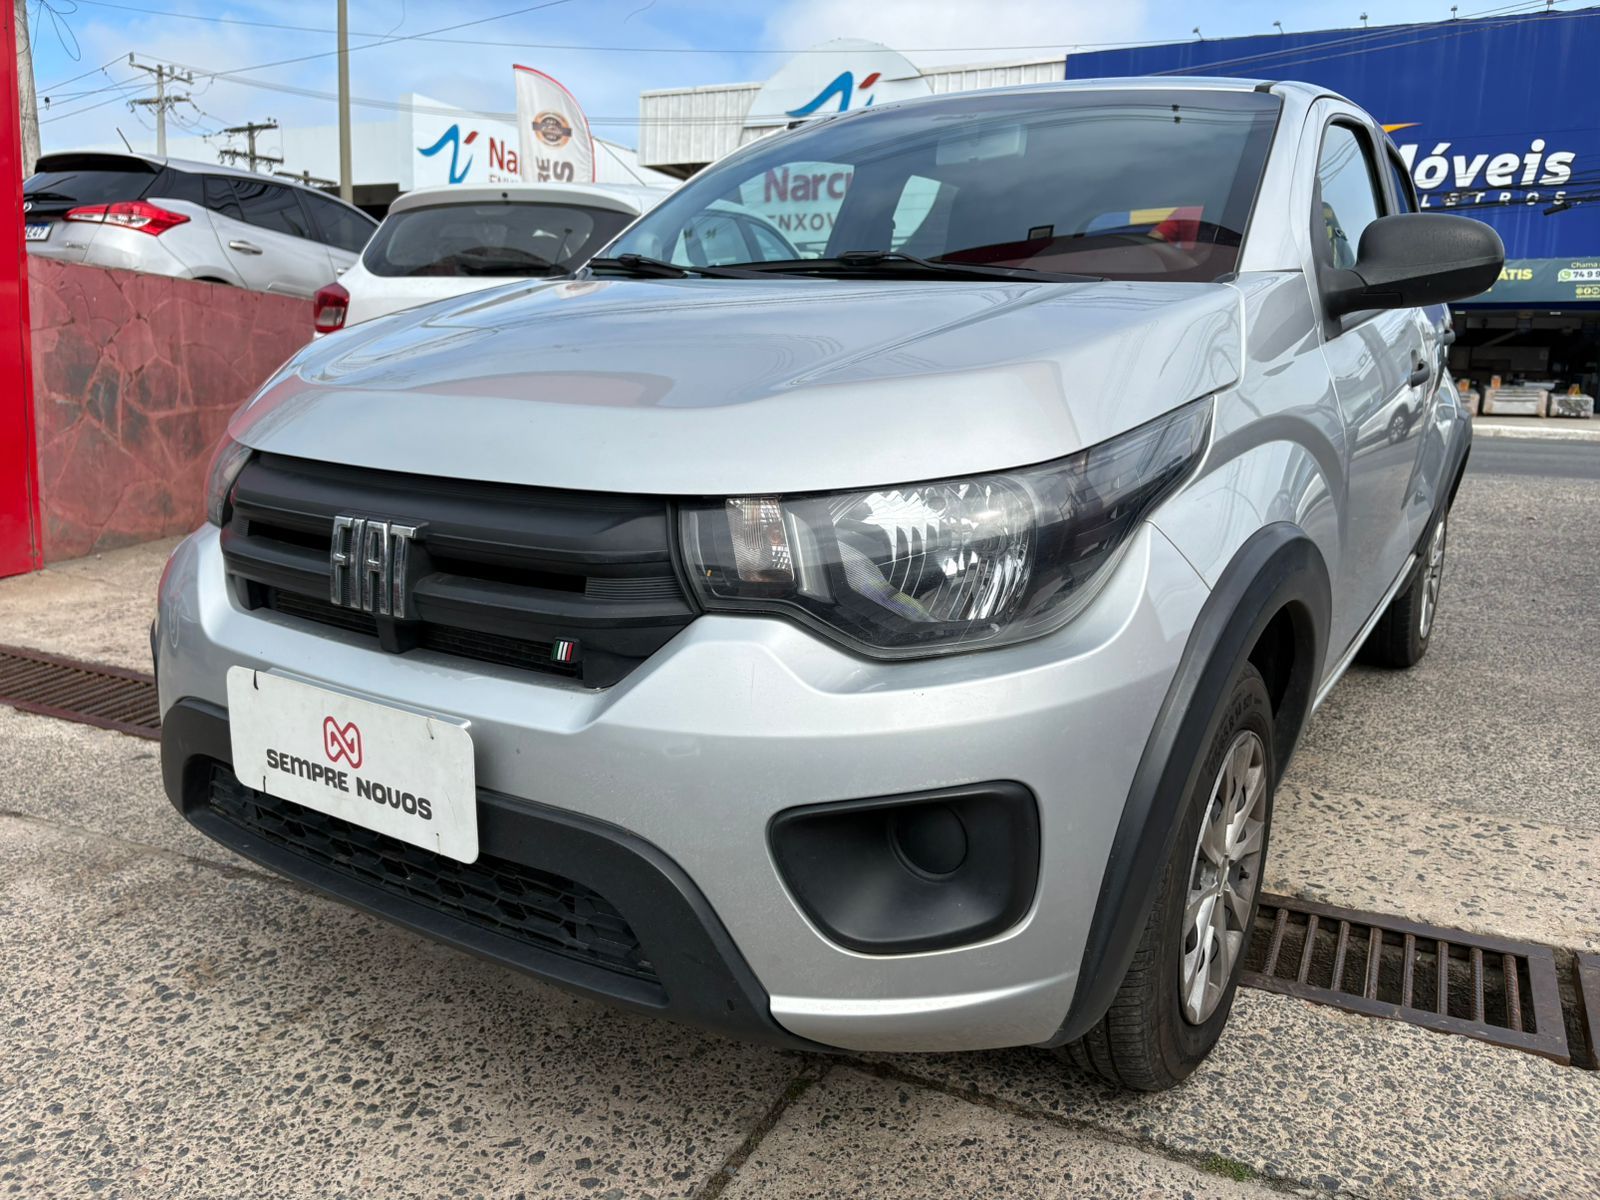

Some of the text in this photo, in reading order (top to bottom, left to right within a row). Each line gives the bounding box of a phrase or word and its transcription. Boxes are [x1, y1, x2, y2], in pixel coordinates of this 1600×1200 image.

[489, 137, 521, 175] Na
[766, 213, 836, 231] NXOV
[330, 515, 416, 618] FIAT
